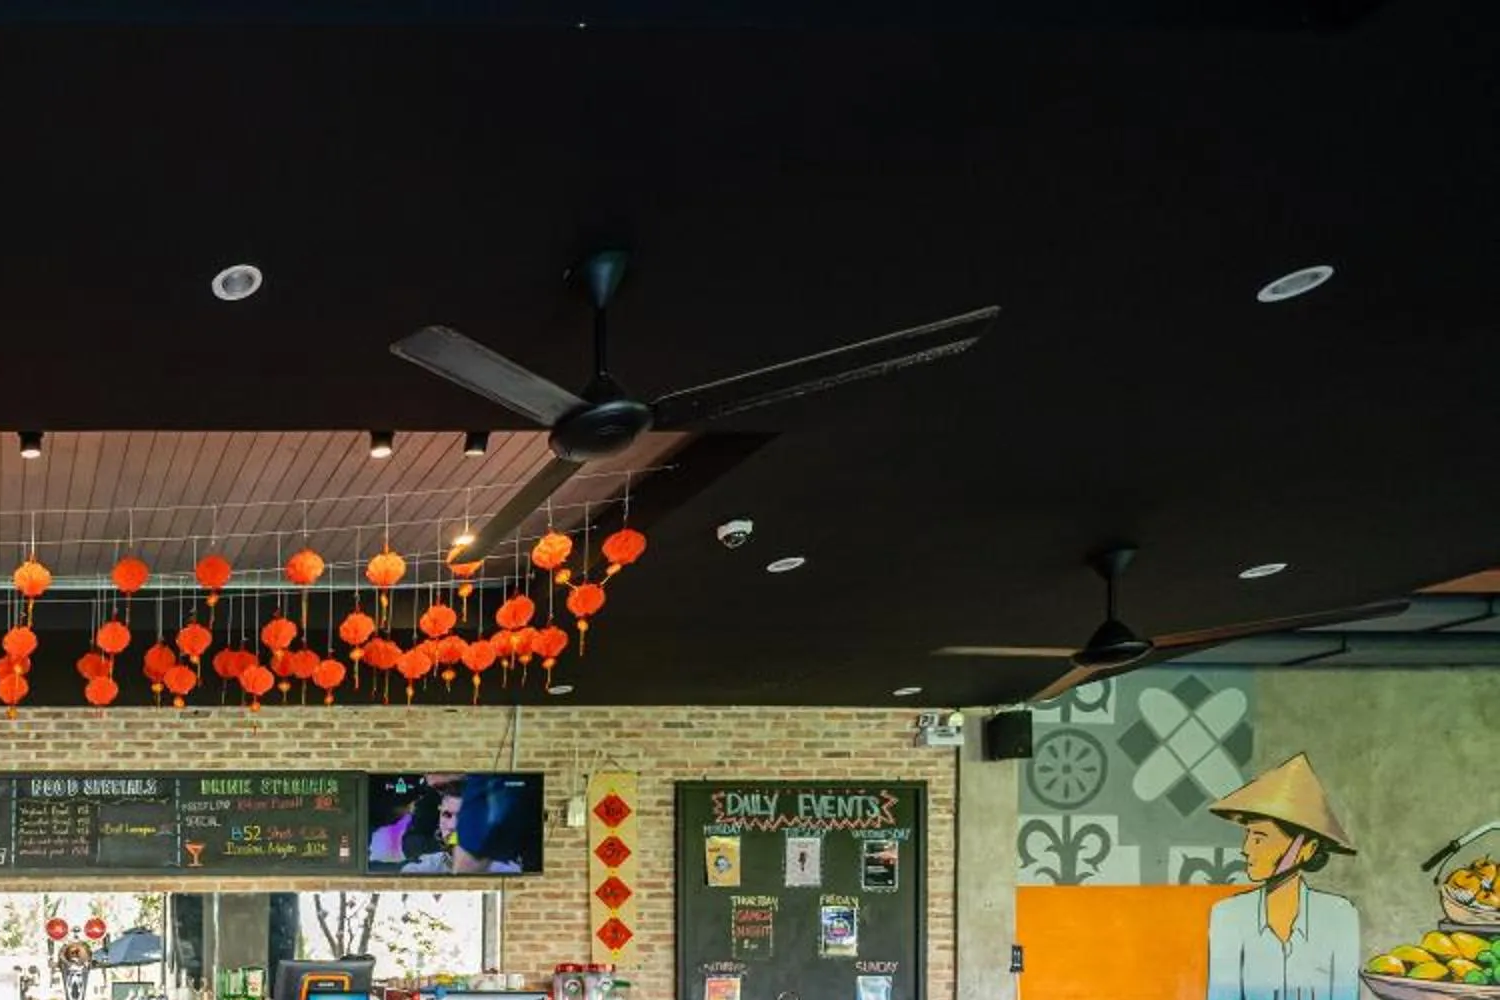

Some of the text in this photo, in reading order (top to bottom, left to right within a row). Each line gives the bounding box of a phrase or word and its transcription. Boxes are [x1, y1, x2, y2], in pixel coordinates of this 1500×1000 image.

[726, 792, 880, 821] DAILY EVENTS
[855, 961, 899, 974] SUNDAY
